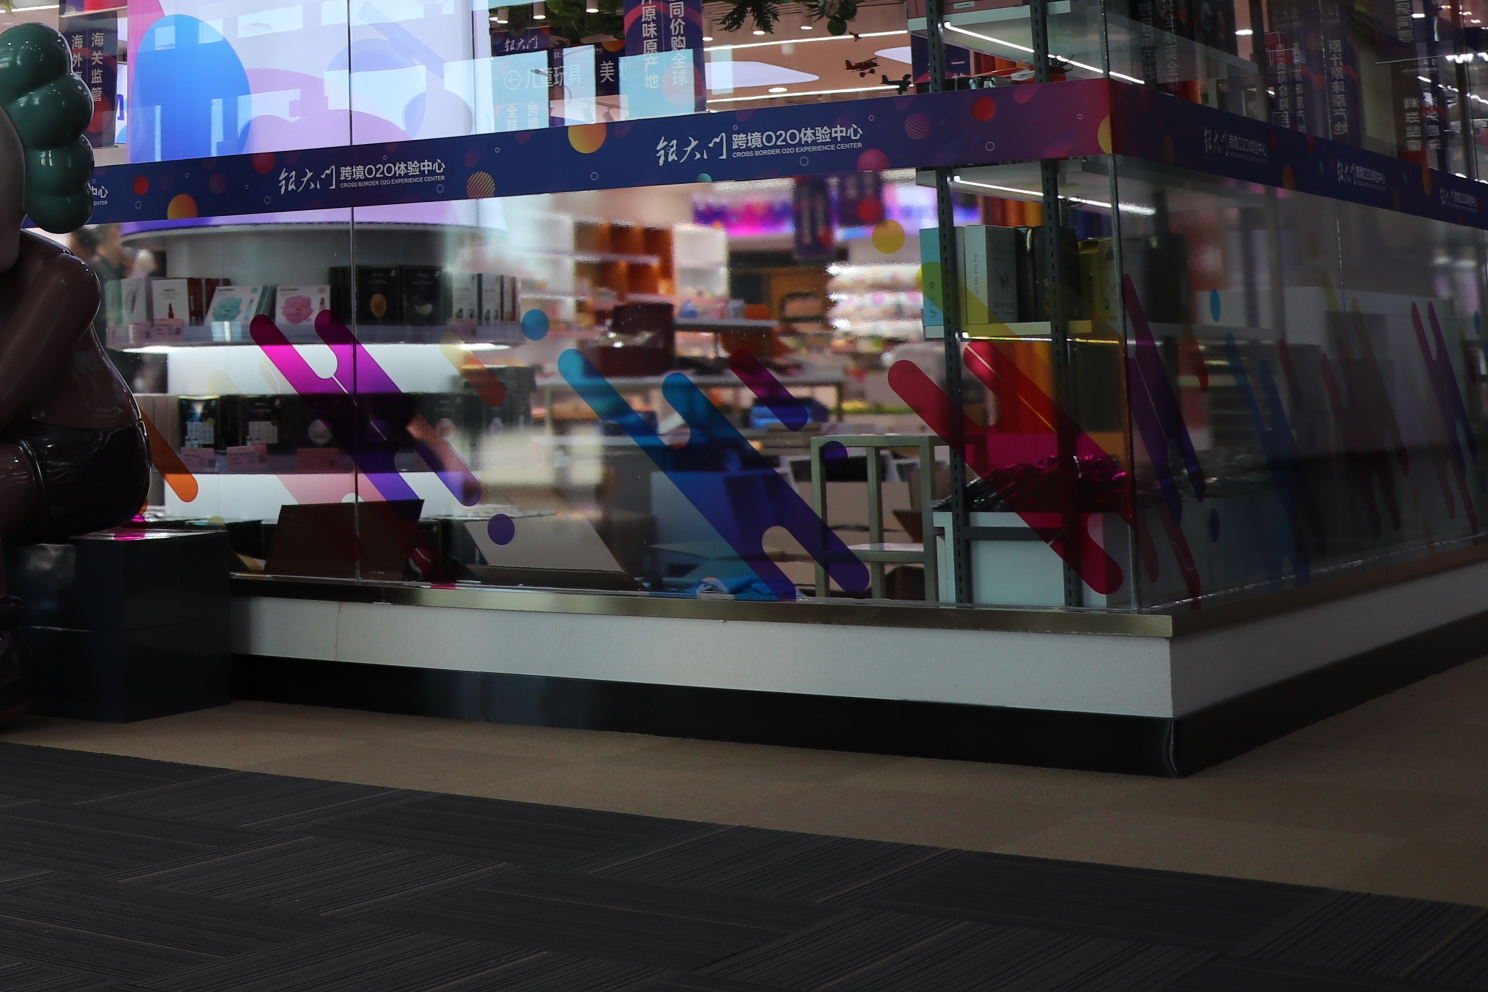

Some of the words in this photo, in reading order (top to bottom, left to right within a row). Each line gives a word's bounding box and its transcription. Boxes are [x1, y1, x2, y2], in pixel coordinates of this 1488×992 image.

[91, 32, 104, 102] 海关监管
[525, 63, 582, 90] 儿童玩具
[731, 123, 863, 150] 跨境O2O体验中心
[732, 150, 754, 158] CROSS
[754, 148, 781, 157] BORDER
[795, 144, 836, 153] EXPERIENCE
[836, 142, 863, 151] CENTER
[340, 158, 445, 181] 跨境O2O体验中心
[391, 176, 424, 185] EXPERIENCE
